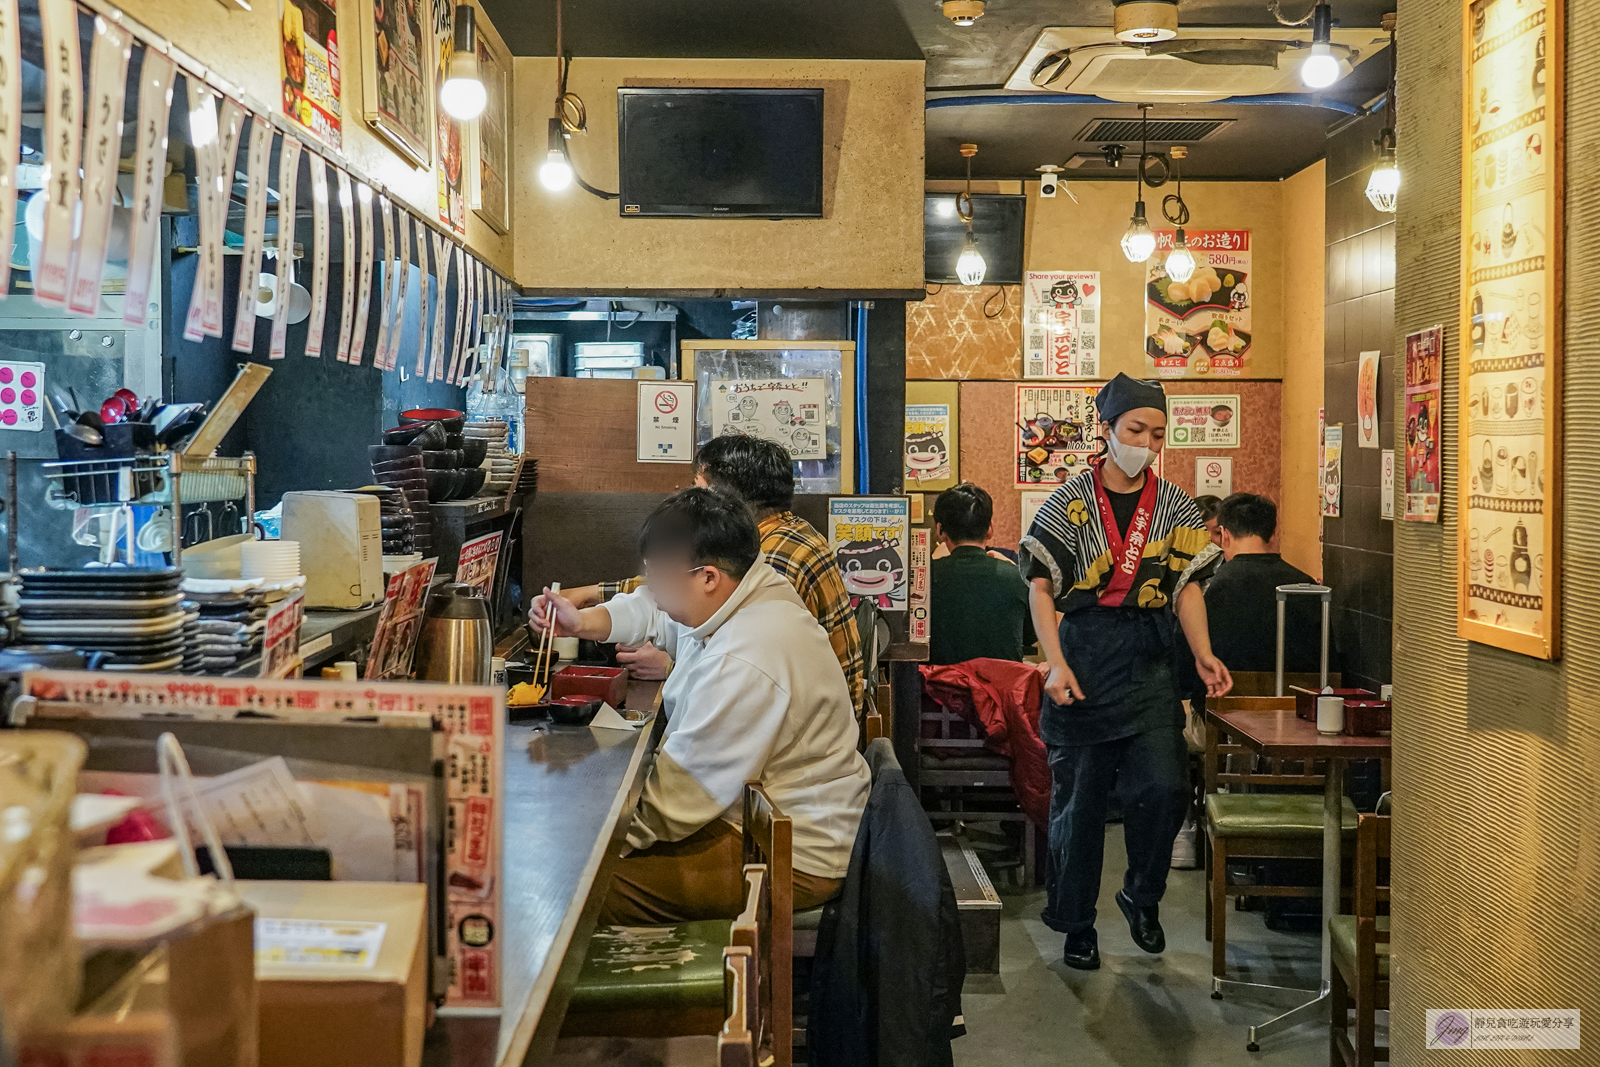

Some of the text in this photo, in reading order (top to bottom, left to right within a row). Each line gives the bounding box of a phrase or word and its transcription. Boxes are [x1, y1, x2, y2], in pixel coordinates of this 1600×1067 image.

[1157, 232, 1241, 250] 帆のお造り
[1029, 272, 1096, 281] Share your reviews!
[1085, 395, 1095, 443] ひつまぶし
[835, 523, 904, 542] 笑顔です!
